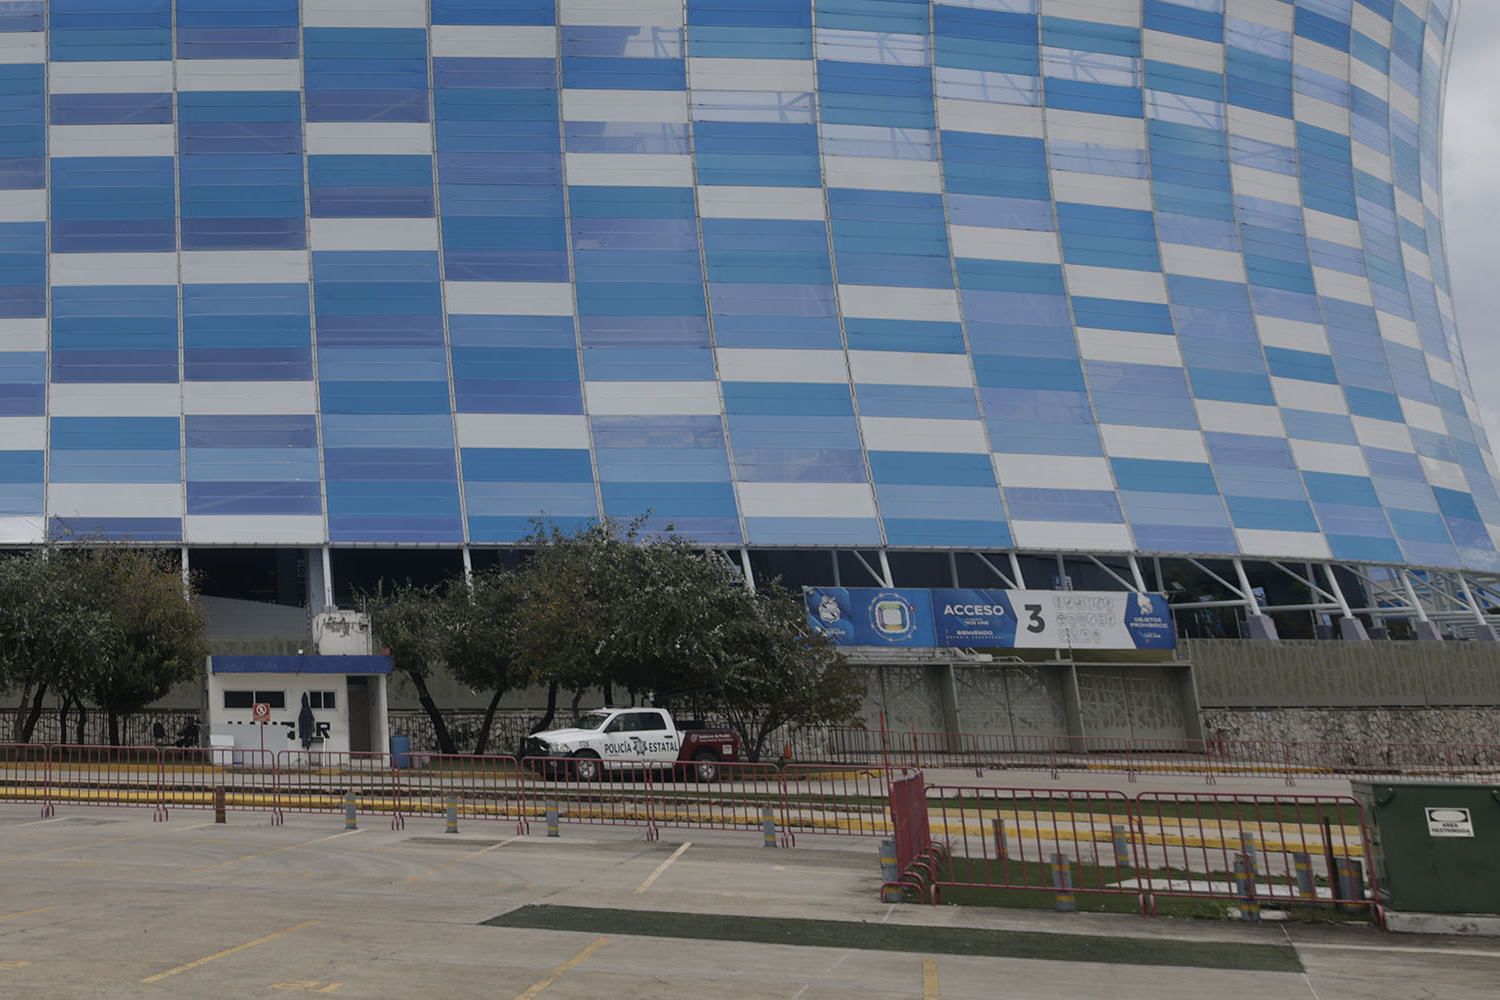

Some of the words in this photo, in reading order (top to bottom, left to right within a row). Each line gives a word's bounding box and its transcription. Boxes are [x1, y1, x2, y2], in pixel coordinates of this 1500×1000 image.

[944, 605, 1004, 615] ACCESO
[1024, 604, 1045, 634] 3
[604, 741, 632, 753] POLICÍA
[649, 742, 678, 752] ESTATAL
